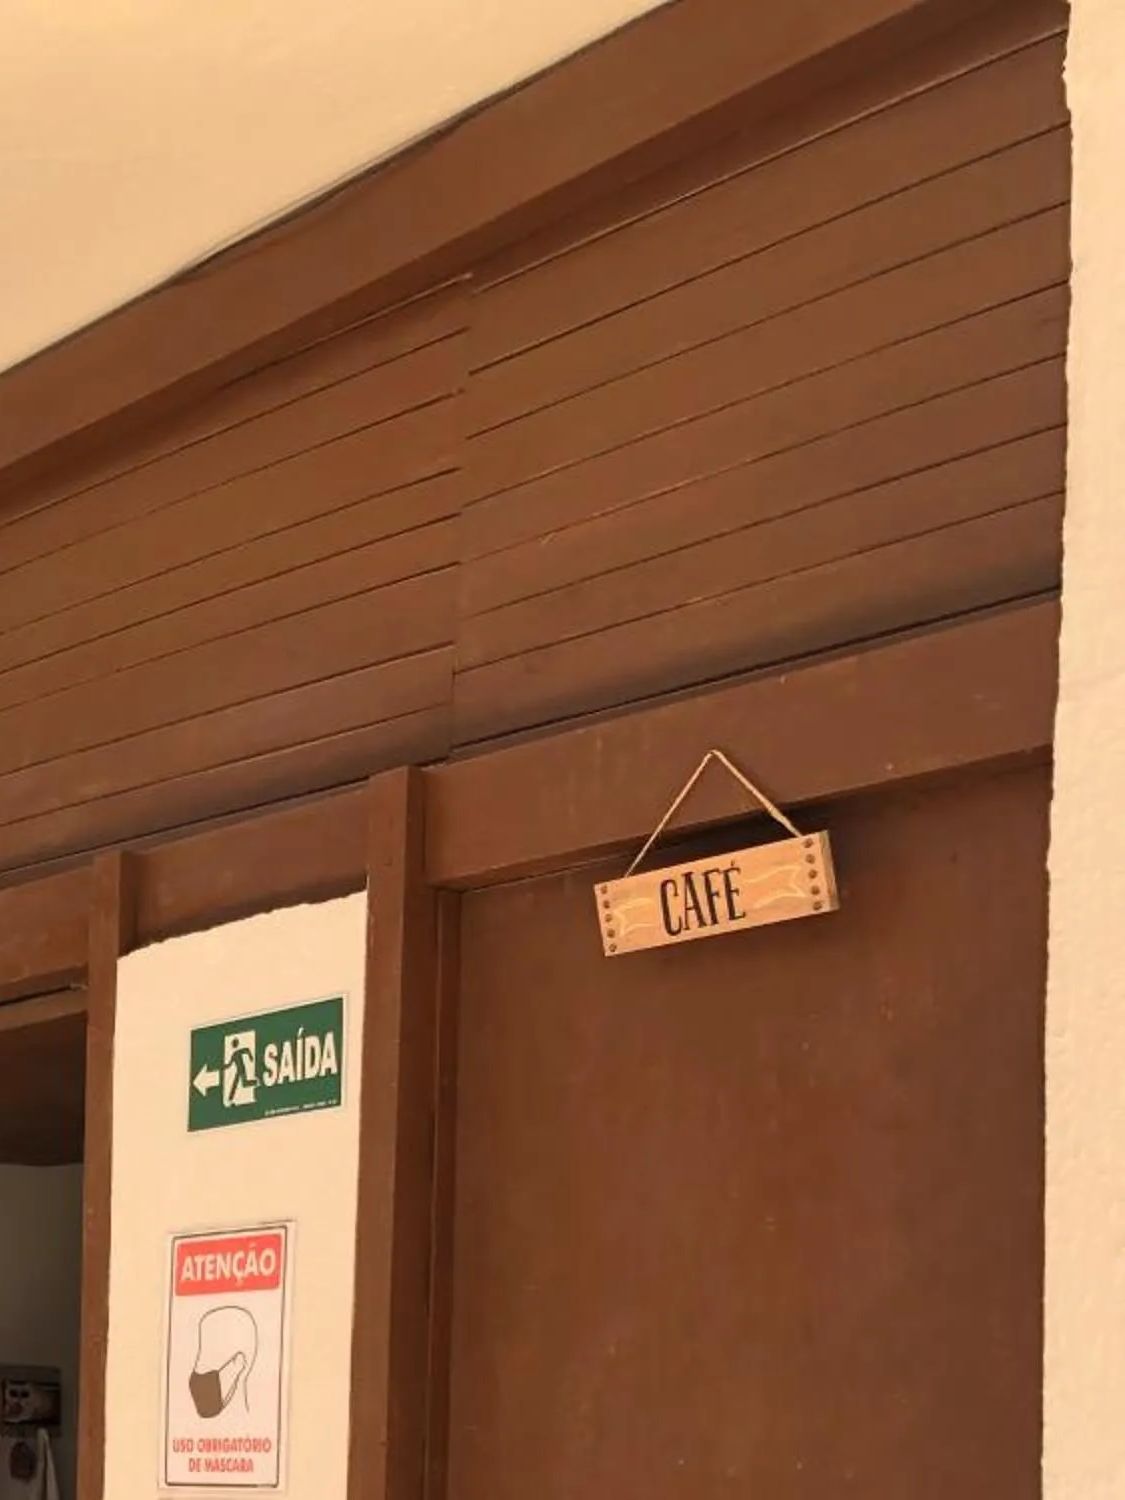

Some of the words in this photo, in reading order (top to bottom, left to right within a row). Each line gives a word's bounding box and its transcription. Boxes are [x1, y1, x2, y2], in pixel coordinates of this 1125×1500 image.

[660, 860, 745, 936] CAFÉ
[262, 1025, 338, 1087] SAÍDA
[181, 1243, 276, 1286] ATENÇÃO
[172, 1439, 194, 1453] USO
[197, 1437, 272, 1453] OBRIGATÓRIO
[188, 1459, 201, 1473] DE
